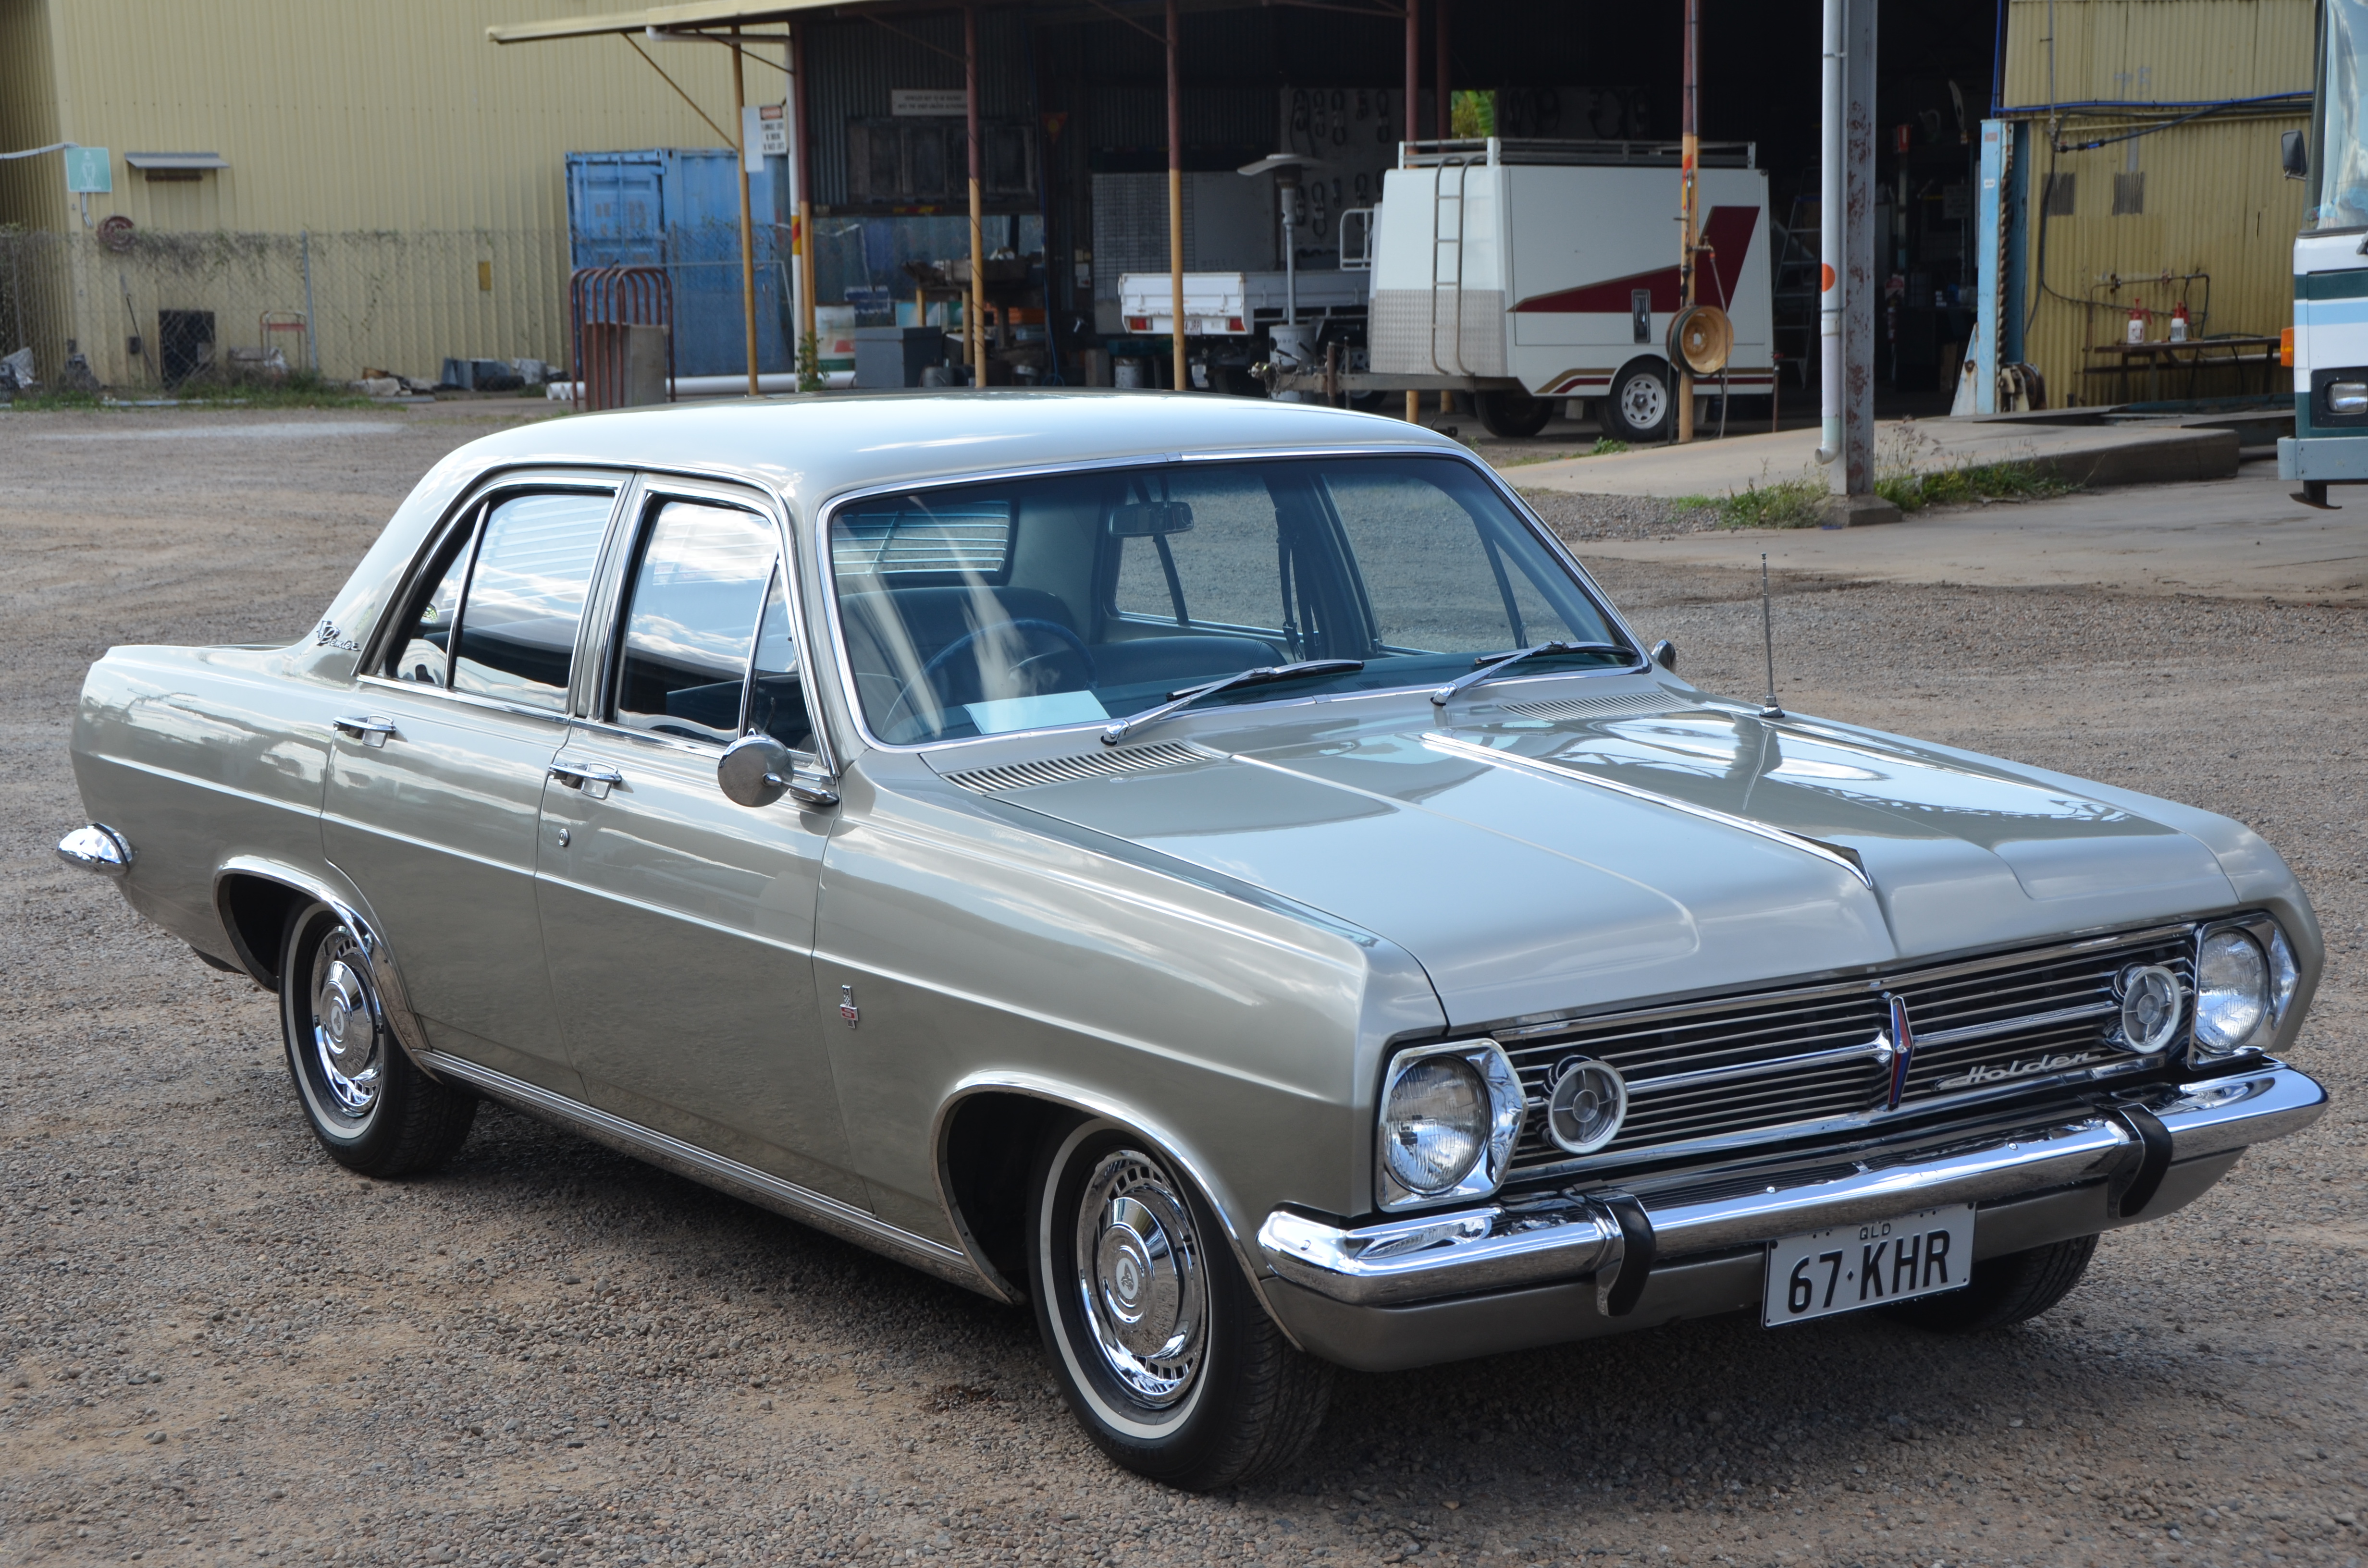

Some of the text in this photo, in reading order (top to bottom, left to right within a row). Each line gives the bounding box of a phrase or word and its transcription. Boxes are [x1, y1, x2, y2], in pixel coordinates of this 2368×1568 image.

[317, 625, 361, 650] Premier
[1936, 1052, 2101, 1090] Holden
[1860, 1223, 1891, 1240] QLD
